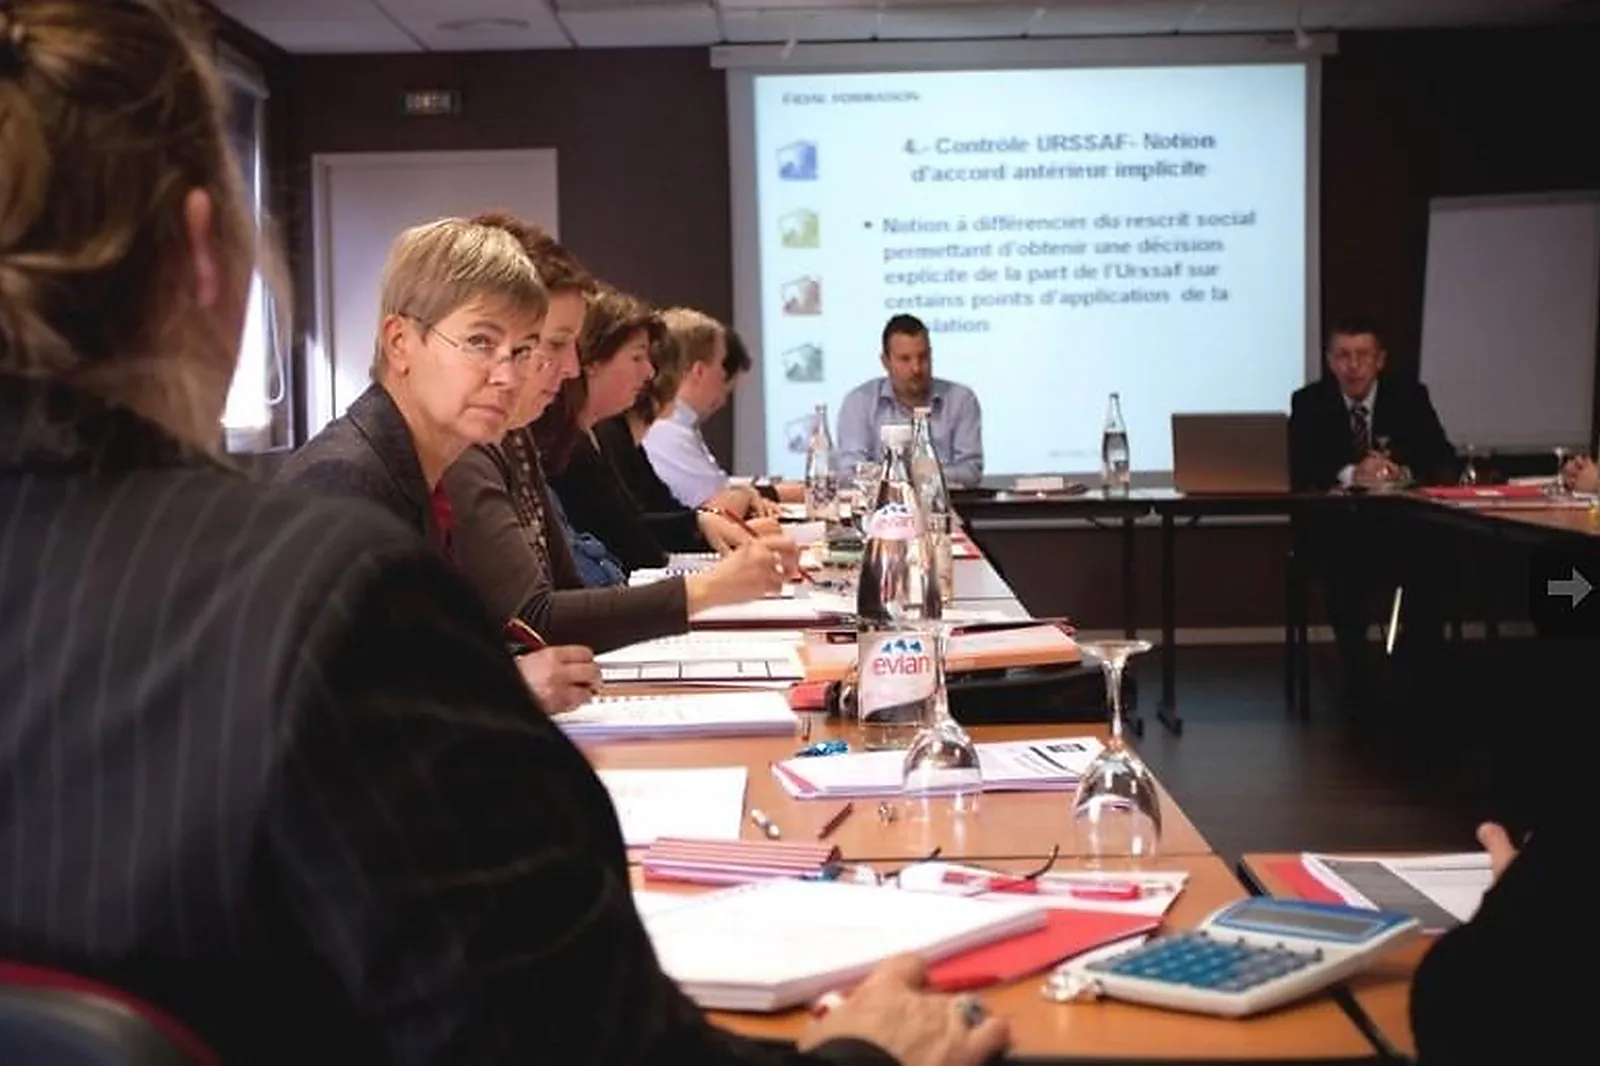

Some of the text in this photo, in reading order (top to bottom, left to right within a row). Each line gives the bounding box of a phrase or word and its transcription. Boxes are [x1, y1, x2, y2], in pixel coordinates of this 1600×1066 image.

[934, 136, 1031, 155] Contrôle
[1144, 133, 1217, 149] Notion
[911, 159, 1210, 183] d'accord antérieur implicite
[882, 210, 1257, 234] Notion à différencier du rescrit social
[883, 237, 1225, 264] permettant d'obtenir une décision
[884, 261, 1220, 287] explicite de la part de l'Urssaf sur
[884, 286, 1229, 310] certains points d'application de la
[929, 318, 990, 334] lation
[873, 654, 930, 676] evian
